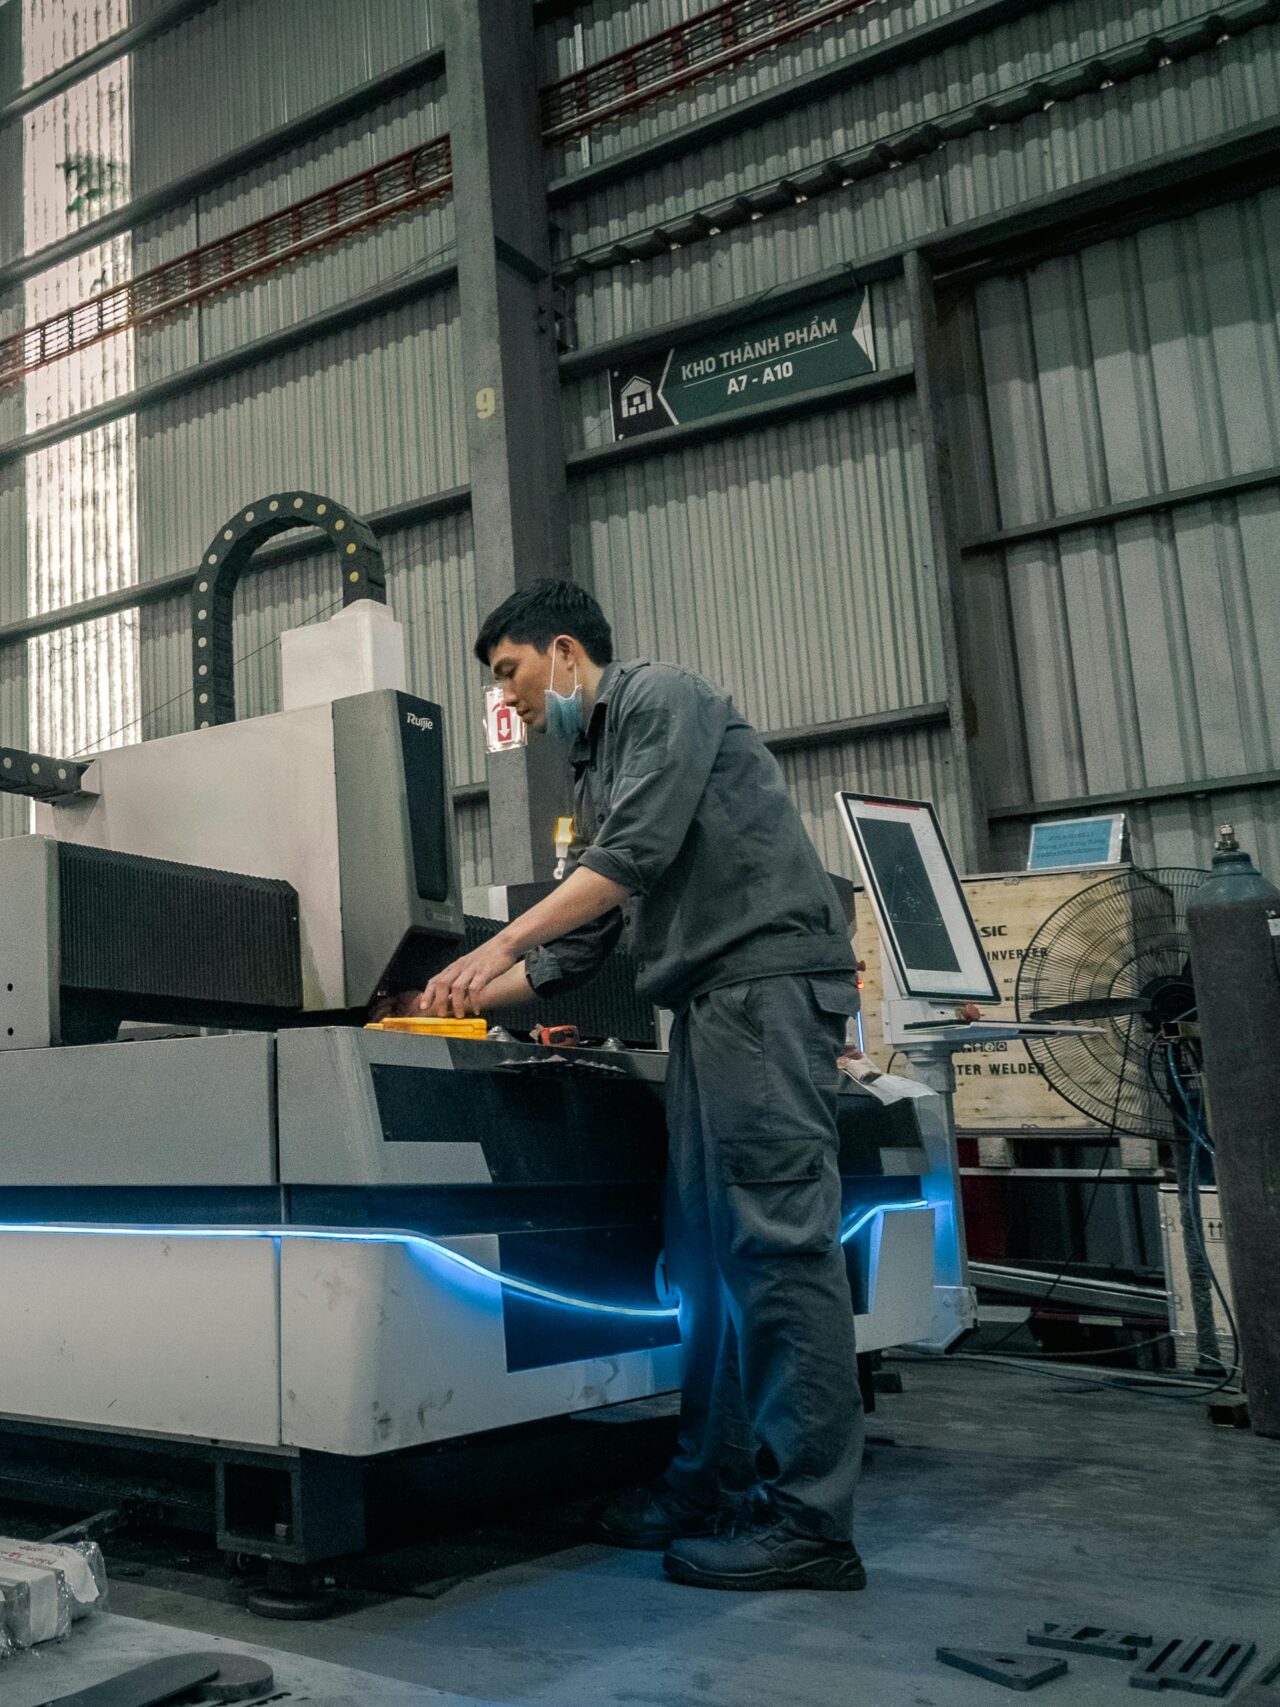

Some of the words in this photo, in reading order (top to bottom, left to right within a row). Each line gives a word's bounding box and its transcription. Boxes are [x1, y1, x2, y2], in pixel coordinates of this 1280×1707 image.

[681, 356, 716, 381] KHO
[720, 336, 780, 368] THÀNH
[784, 315, 838, 348] PHẨM
[727, 374, 748, 395] A7
[762, 361, 794, 385] A10
[475, 387, 495, 419] 9
[406, 711, 433, 731] Ruijie
[986, 947, 1049, 961] INVERTER
